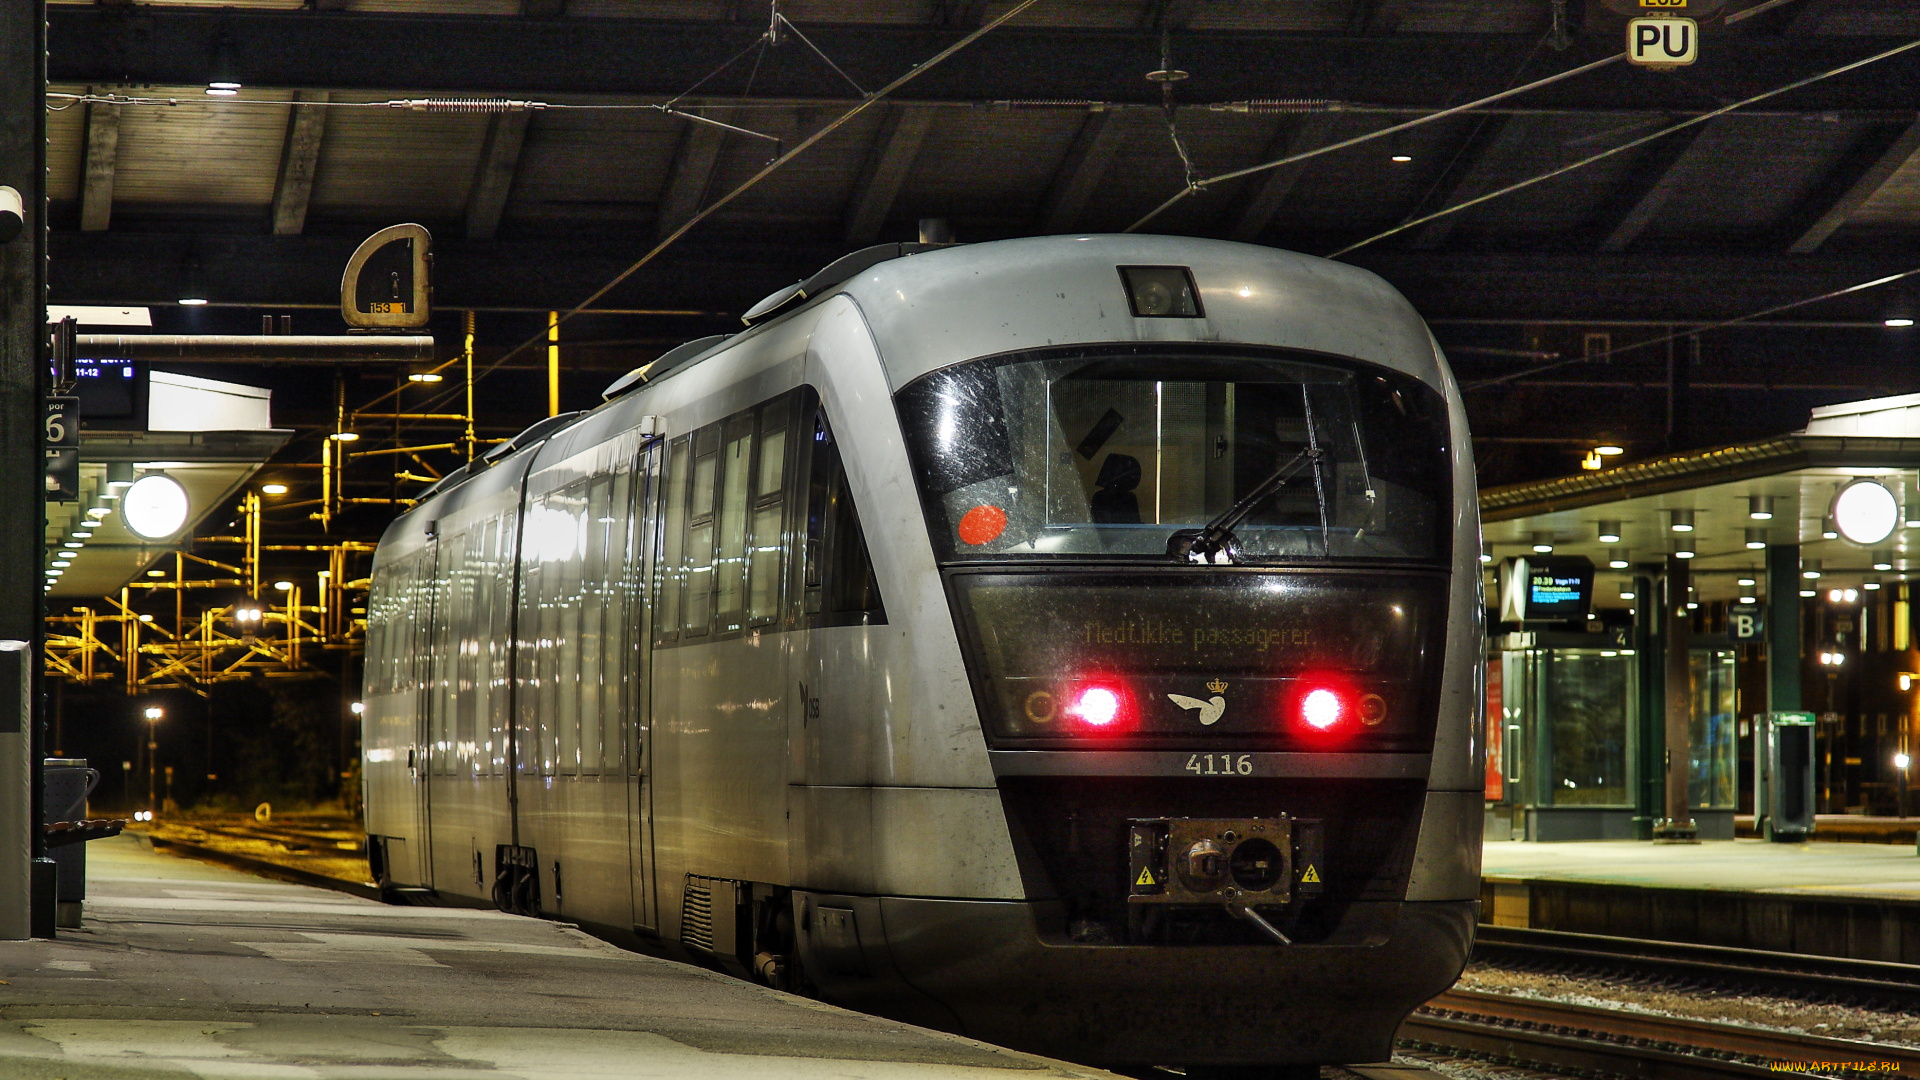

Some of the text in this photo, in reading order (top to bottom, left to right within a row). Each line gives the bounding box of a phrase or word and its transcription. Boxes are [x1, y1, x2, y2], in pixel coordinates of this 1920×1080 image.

[1637, 25, 1689, 57] PU
[370, 303, 391, 313] 153
[47, 403, 65, 411] por
[46, 413, 65, 442] 6
[1737, 615, 1754, 637] B
[1616, 633, 1626, 646] 4
[809, 698, 819, 718] DSB
[1186, 754, 1253, 775] 4116
